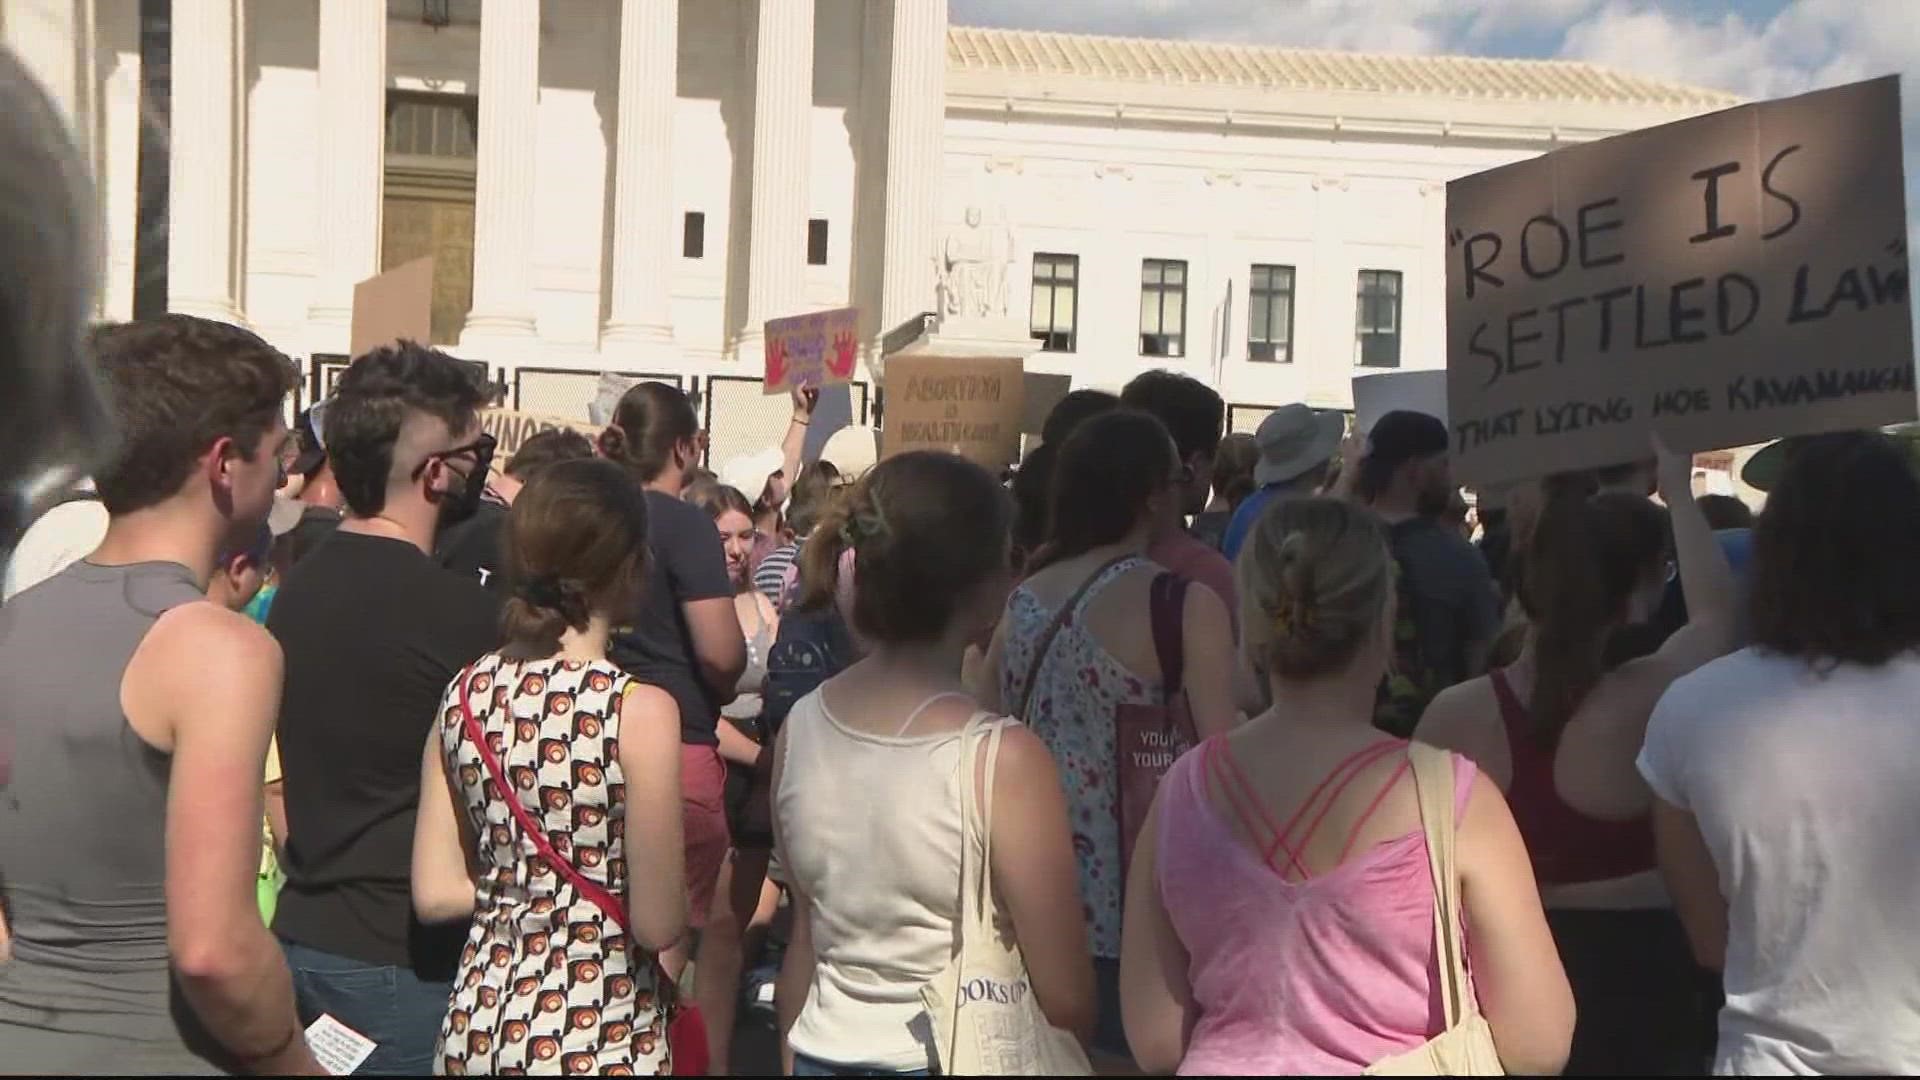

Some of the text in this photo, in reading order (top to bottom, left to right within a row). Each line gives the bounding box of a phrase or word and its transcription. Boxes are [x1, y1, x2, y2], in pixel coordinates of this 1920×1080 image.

[1689, 144, 1803, 244] IS
[1468, 273, 1760, 389] SETTLED
[1455, 407, 1525, 456] THAT
[1534, 396, 1634, 436] LYING
[1652, 387, 1711, 417] HOE
[1132, 752, 1174, 768] YOUR
